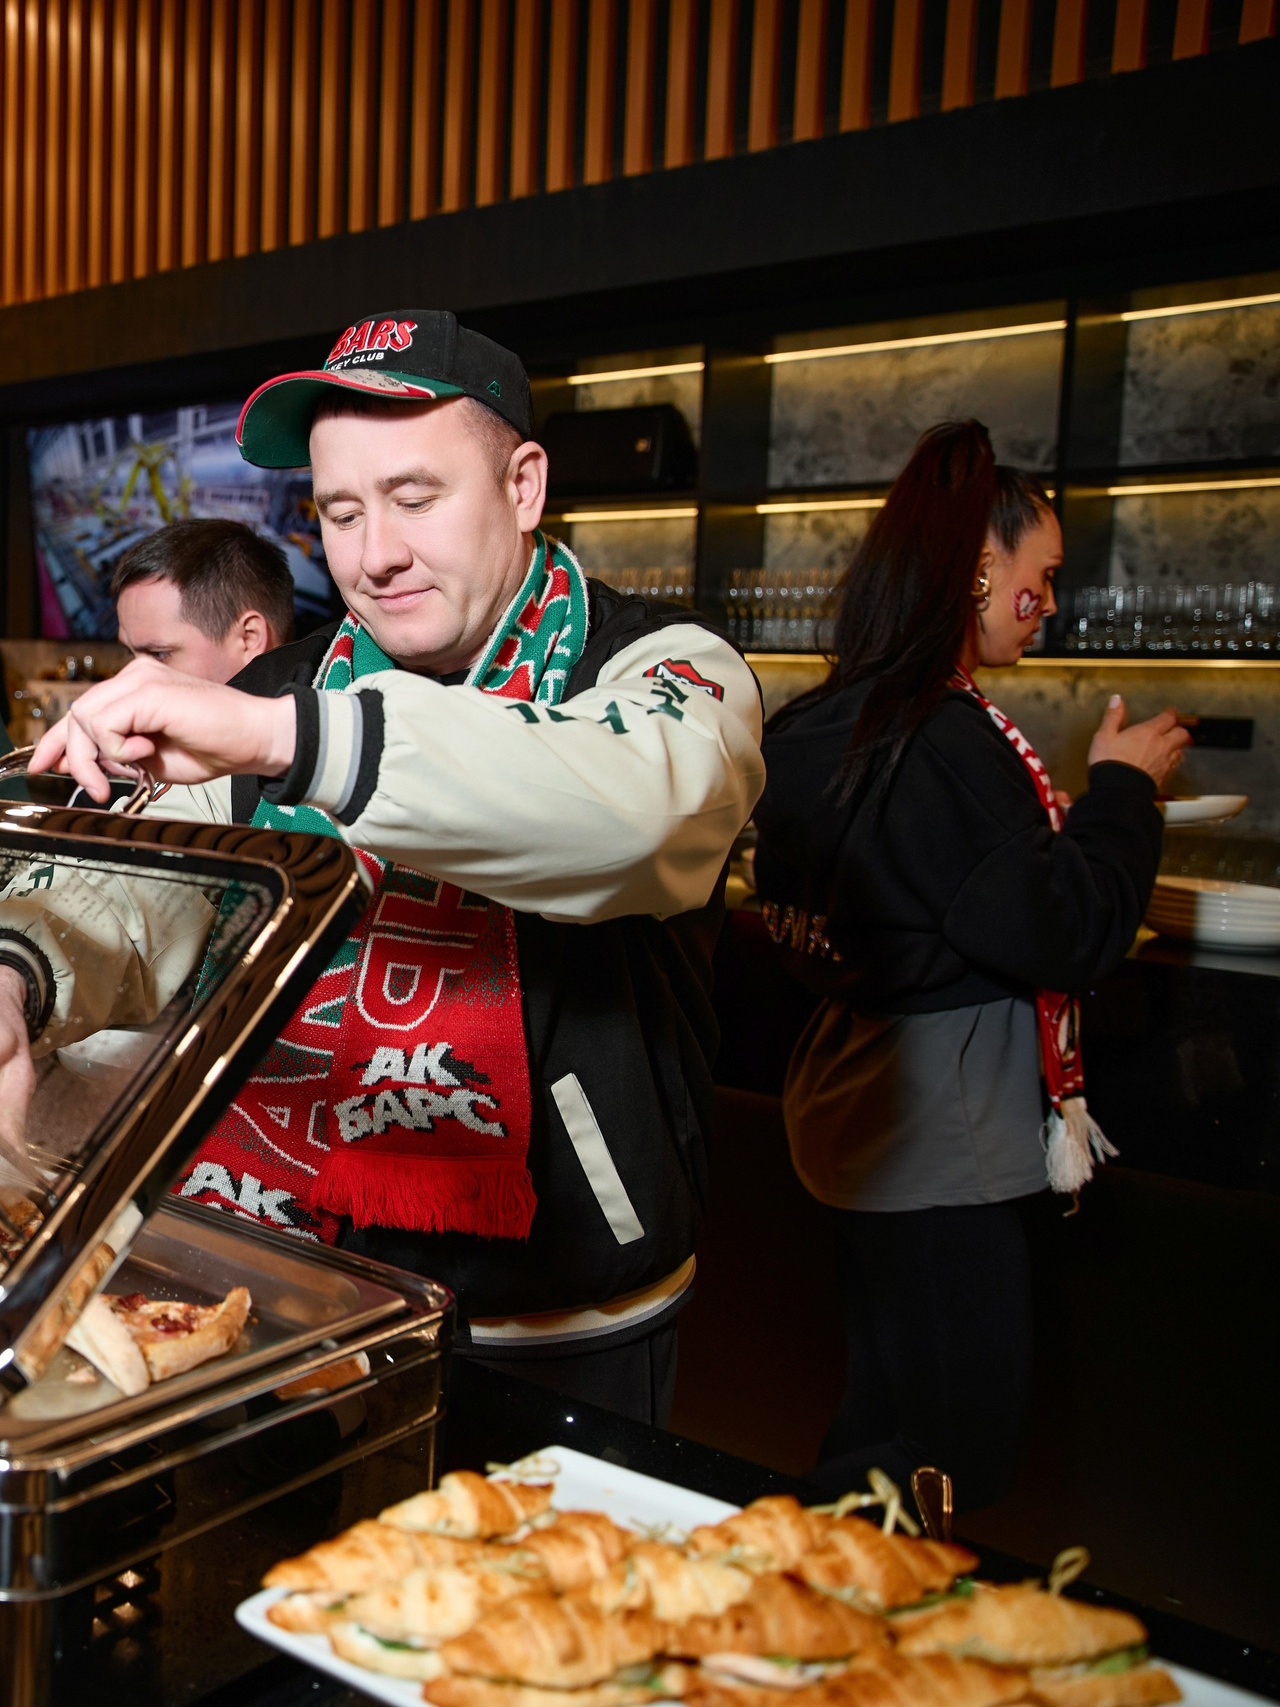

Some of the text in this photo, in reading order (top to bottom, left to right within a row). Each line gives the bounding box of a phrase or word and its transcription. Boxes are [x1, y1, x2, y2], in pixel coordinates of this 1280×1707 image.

[327, 352, 385, 371] KEY CLUB
[328, 318, 418, 364] BARS
[360, 1041, 462, 1087] АК
[333, 1088, 508, 1142] БАРС
